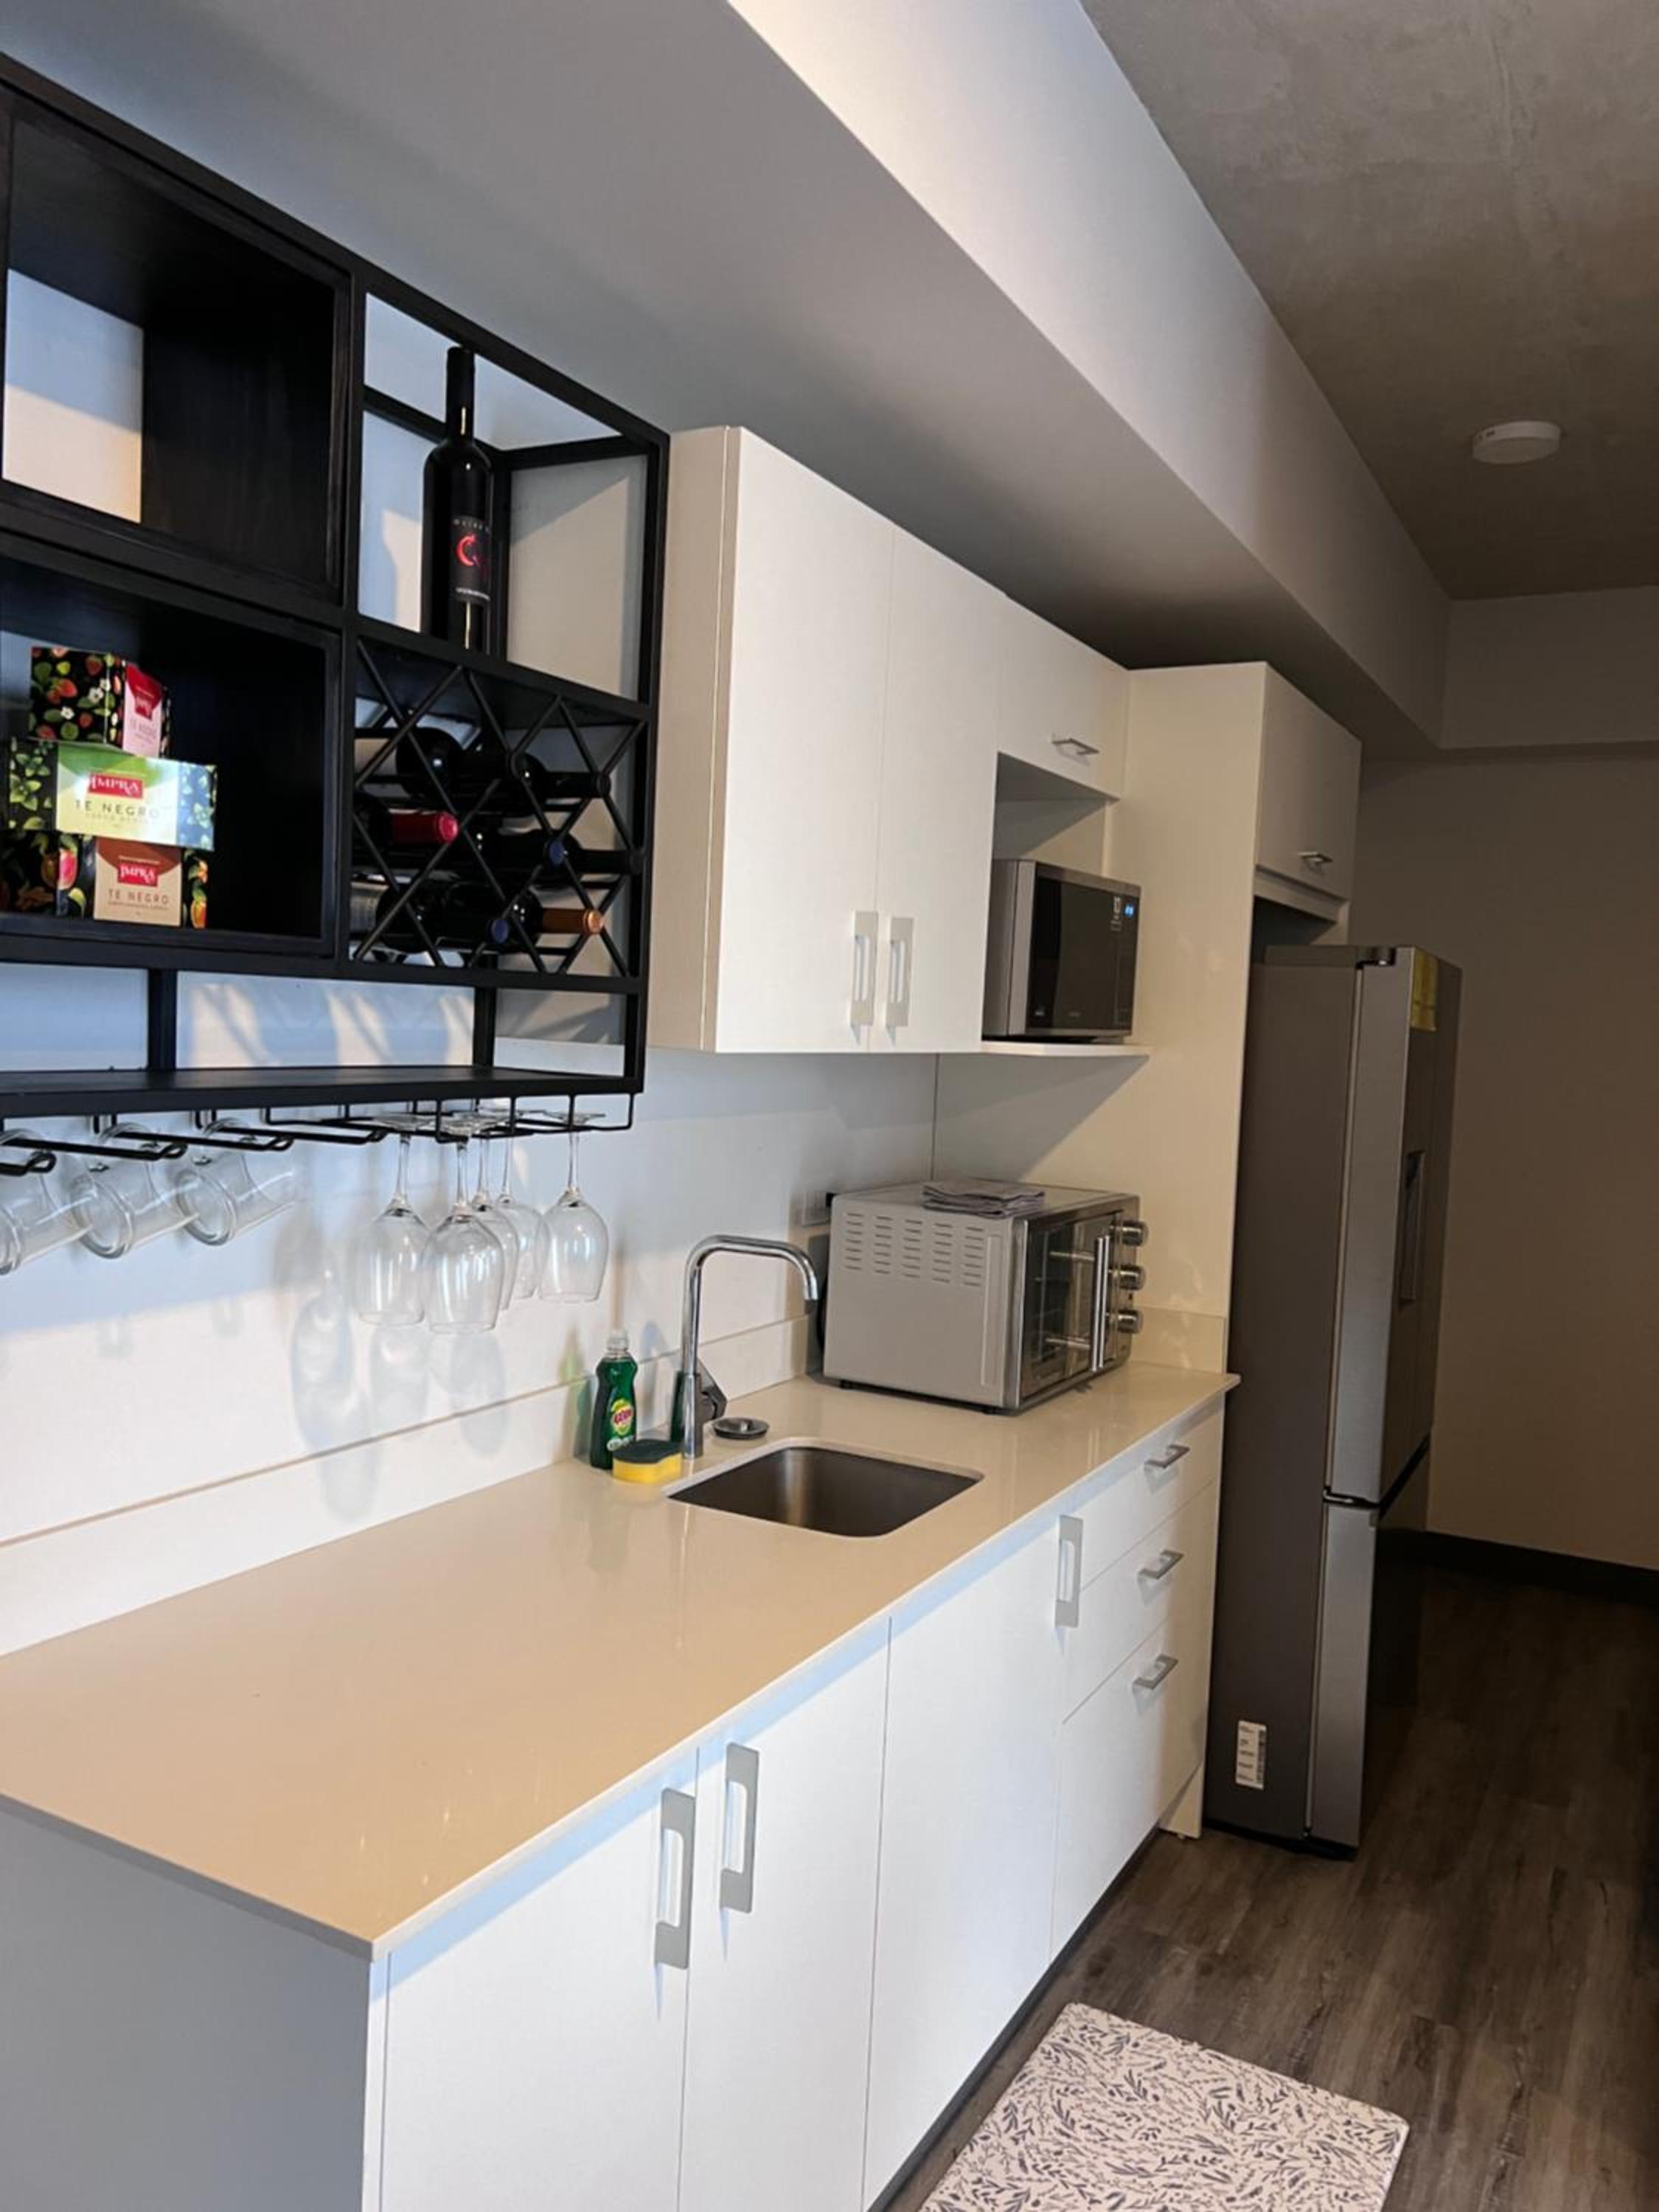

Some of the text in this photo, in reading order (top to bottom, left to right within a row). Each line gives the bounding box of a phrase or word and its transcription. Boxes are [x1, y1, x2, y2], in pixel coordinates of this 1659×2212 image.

[91, 775, 140, 797] IMPRA
[76, 799, 92, 811] TE
[102, 802, 159, 819] NEGRO
[119, 863, 157, 885] IMPRA
[108, 888, 170, 905] TE NEGRO
